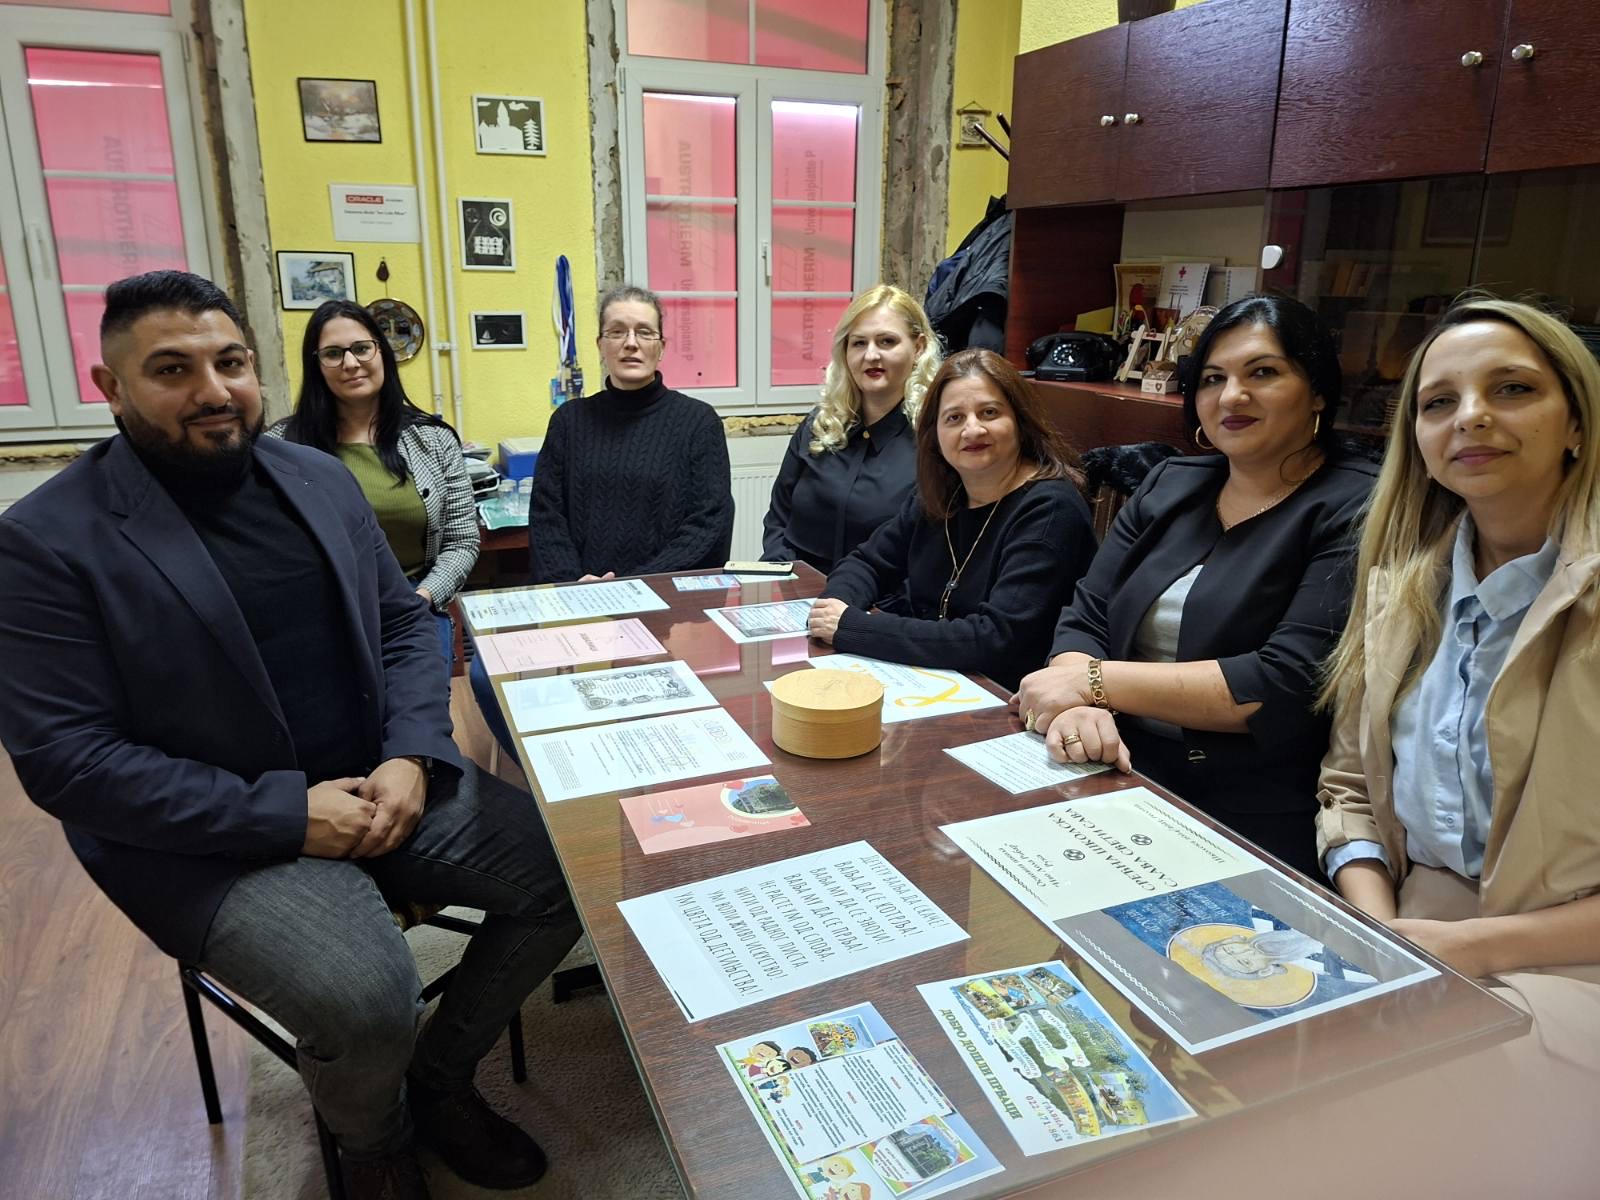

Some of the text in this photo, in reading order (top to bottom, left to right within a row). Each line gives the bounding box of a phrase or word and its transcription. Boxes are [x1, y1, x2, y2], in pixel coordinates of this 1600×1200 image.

[1048, 812, 1156, 891] СРЕЋНА ШКОЛСКА
[1065, 807, 1178, 888] СЛАВА СВЕТИ САВА
[758, 880, 777, 891] НЕ
[808, 867, 837, 887] ВАЉА
[674, 891, 697, 907] УМ
[707, 889, 727, 903] УМ
[764, 888, 794, 910] РАСТЕ
[826, 885, 848, 897] МУ
[833, 860, 923, 938] ВАЉА ДА СЕ КОТРЉА!
[899, 894, 923, 906] ДА
[714, 901, 741, 922] ВОЛИ
[748, 905, 769, 918] ОД
[835, 897, 859, 909] ДА
[683, 905, 714, 931] ЦВЕТА
[781, 908, 804, 923] УМ
[783, 873, 869, 954] ВАЉА МУ ДА СЕ ПРЉА!
[848, 908, 868, 918] СЕ
[699, 928, 723, 944] ОД
[728, 919, 757, 942] ЖИВО
[756, 916, 790, 942] РАДНОГ
[792, 921, 815, 935] ОД
[938, 1009, 968, 1039] ДОБРО
[958, 1039, 994, 1077] ДОШЛИ
[986, 1076, 1024, 1120] ПРВАЦИ
